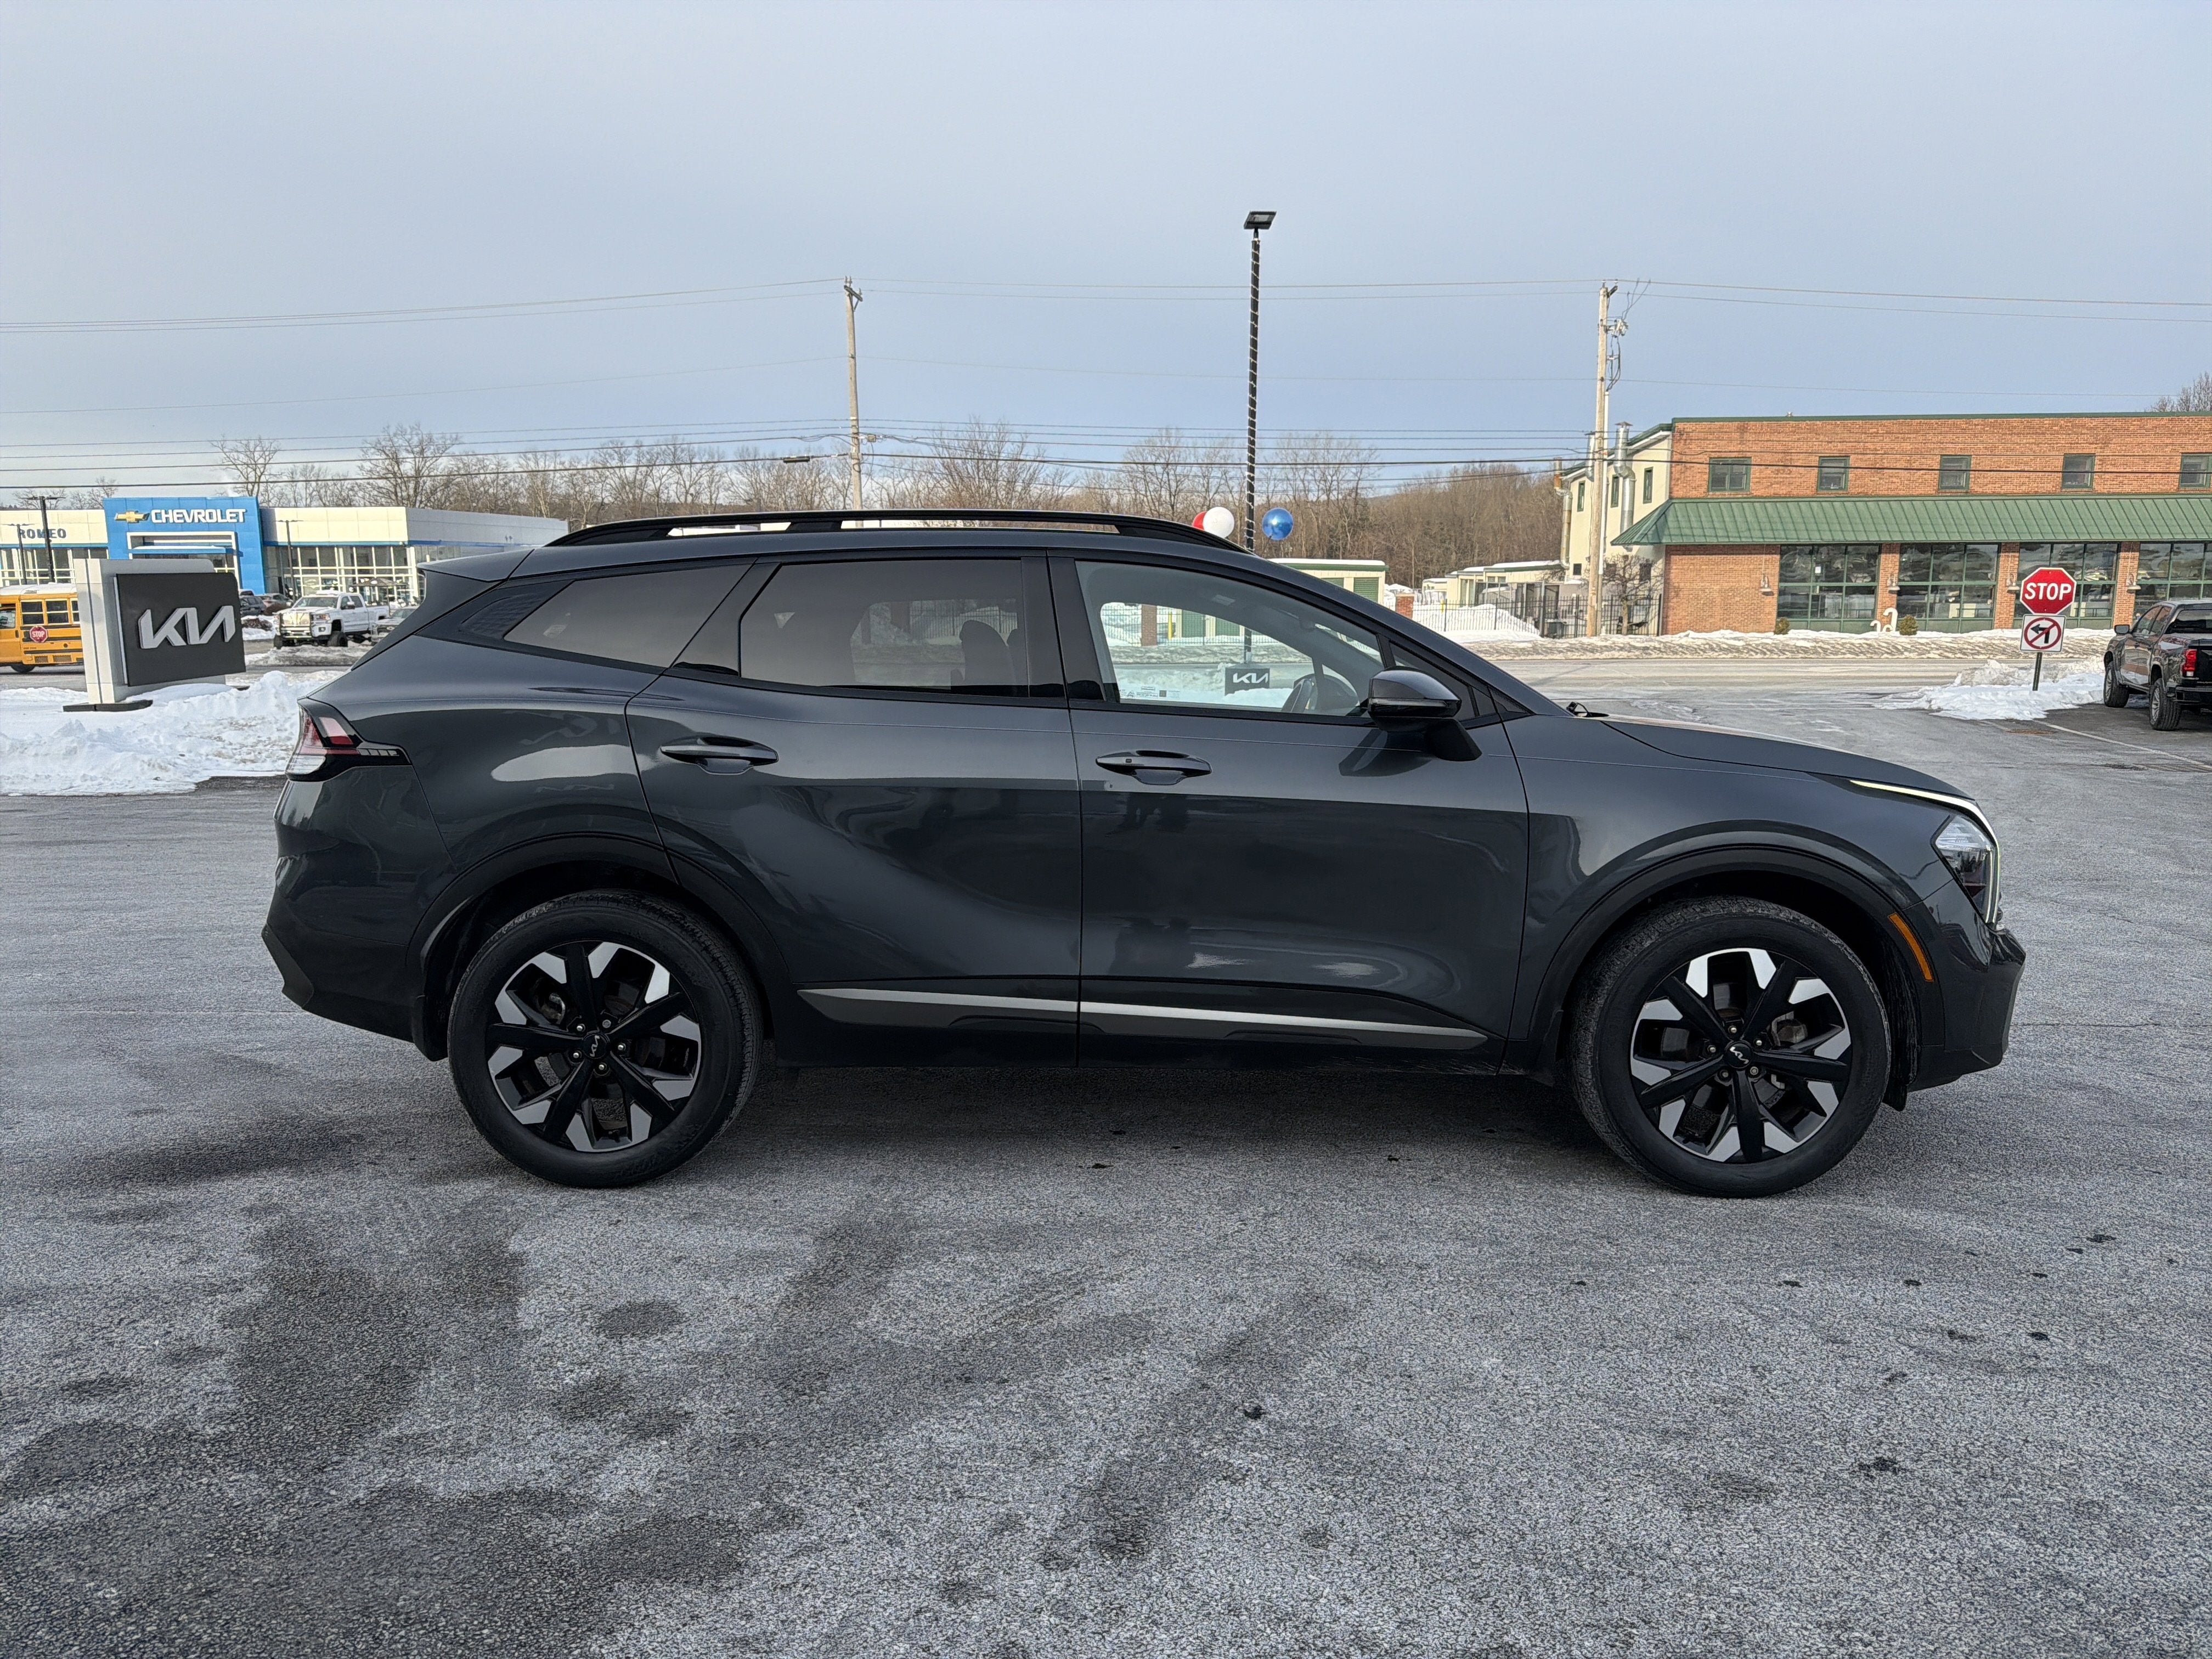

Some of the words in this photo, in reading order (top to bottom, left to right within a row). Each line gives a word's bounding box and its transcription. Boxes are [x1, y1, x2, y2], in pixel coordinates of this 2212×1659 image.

[151, 509, 247, 523] CHEVROLET
[19, 528, 66, 539] ROMEO
[2024, 582, 2072, 600] STOP
[138, 605, 235, 648] KIA
[1233, 673, 1269, 684] KIA
